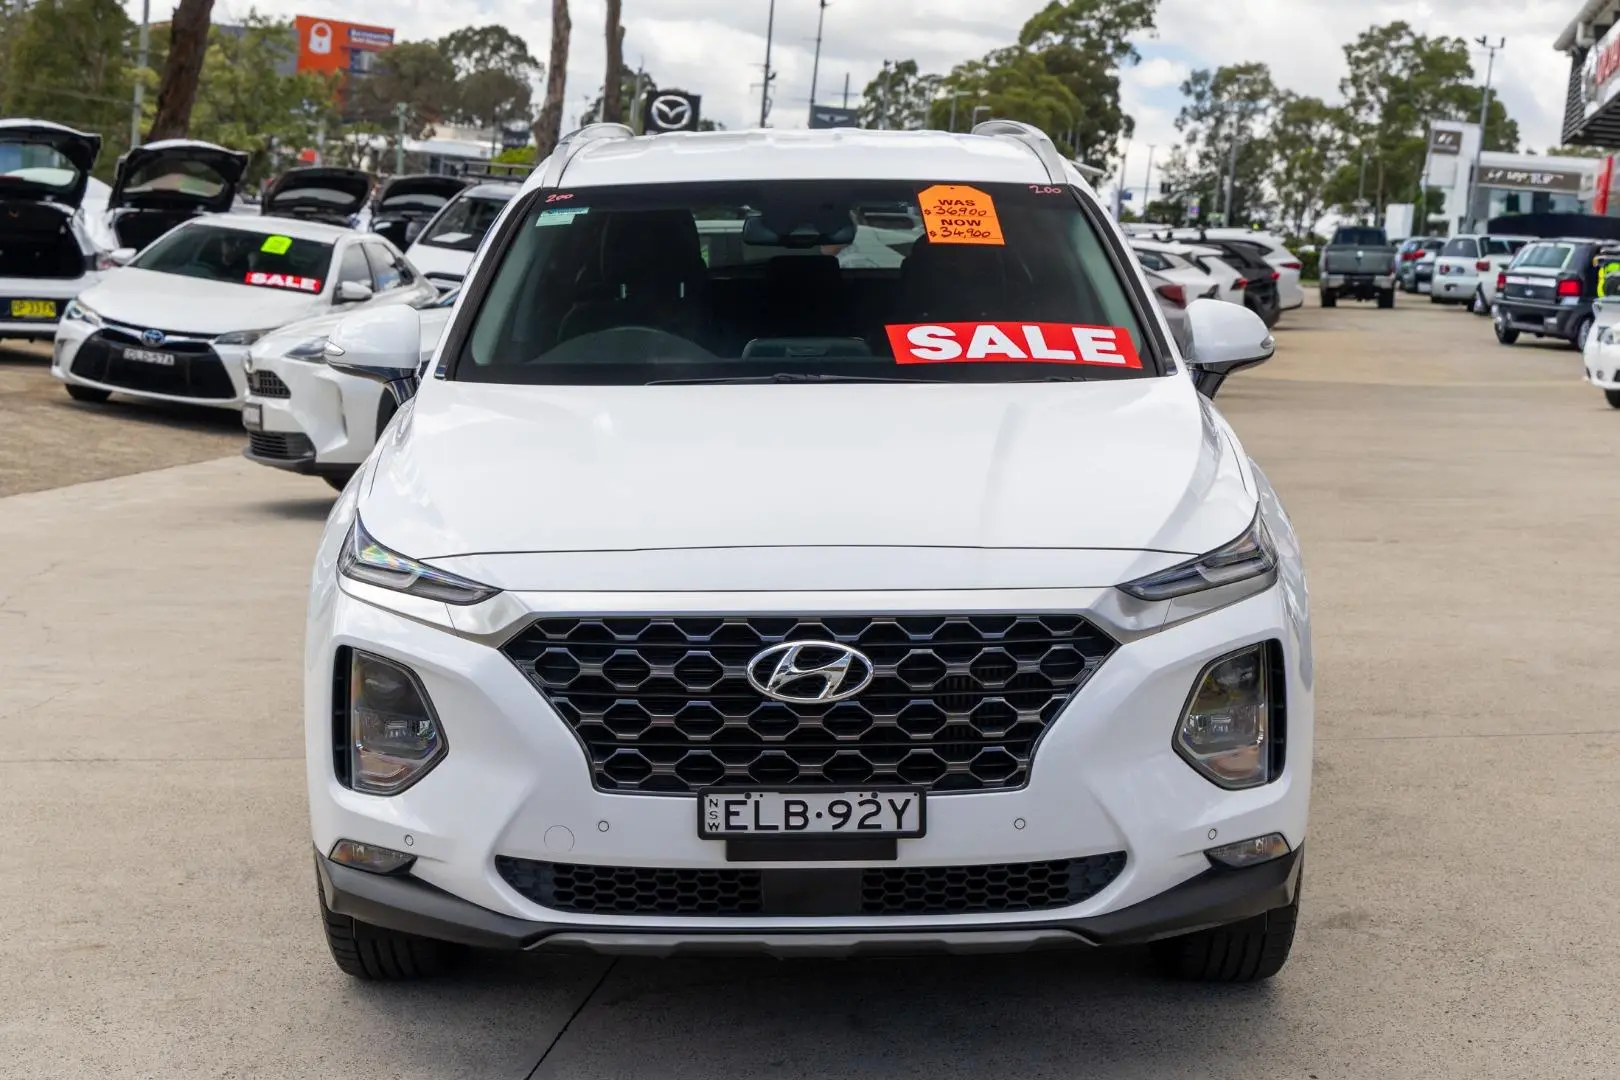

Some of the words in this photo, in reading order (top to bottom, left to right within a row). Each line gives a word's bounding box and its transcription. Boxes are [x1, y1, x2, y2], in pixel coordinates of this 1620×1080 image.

[1029, 185, 1062, 194] 200
[938, 199, 976, 207] WAS
[940, 219, 982, 227] NOW
[251, 272, 317, 291] SALE
[906, 325, 1126, 364] SALE
